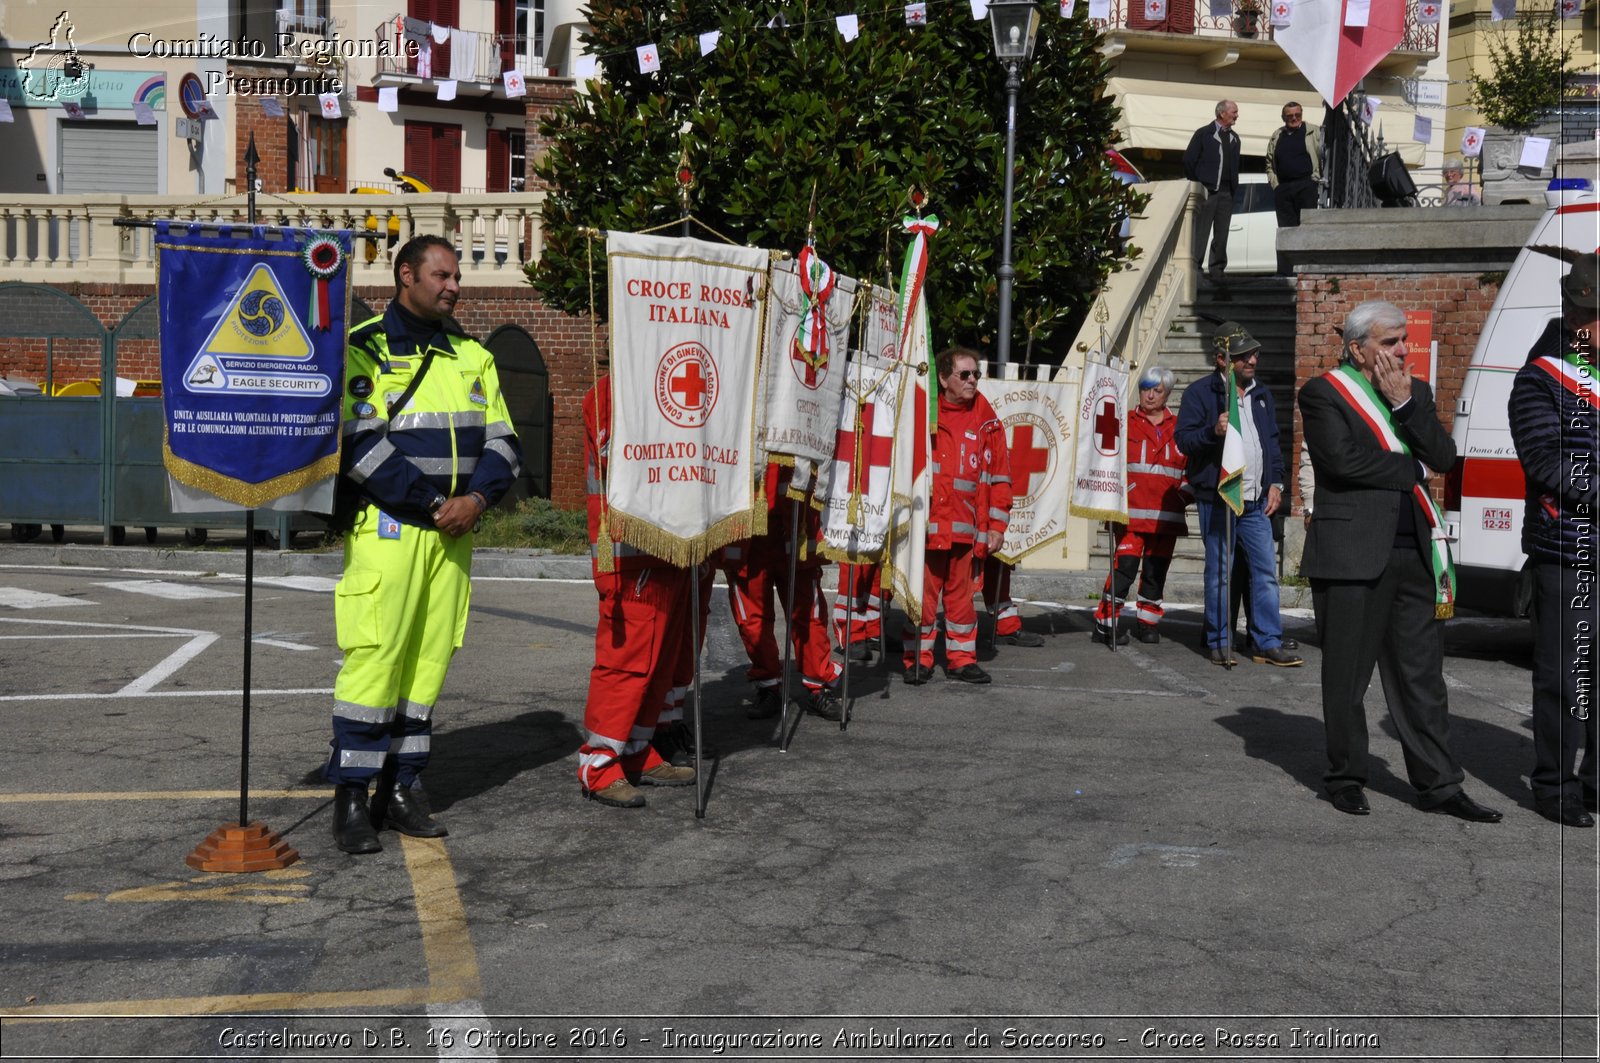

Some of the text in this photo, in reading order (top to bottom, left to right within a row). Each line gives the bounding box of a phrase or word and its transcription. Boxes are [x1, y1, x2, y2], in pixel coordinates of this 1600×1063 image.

[627, 279, 752, 308] CROCE ROSSA
[649, 304, 731, 329] ITALIANA
[231, 320, 291, 345] PROTEZIONE CIVILE
[226, 361, 256, 369] SERVIZIO
[257, 362, 296, 370] EMERGENZA
[666, 354, 677, 366] DI
[233, 378, 320, 389] EAGLE SECURITY
[659, 364, 683, 420] CONVENZIONE
[1082, 387, 1096, 421] CROCE
[174, 410, 335, 424] UNITA' AUSILIARIA VOLONTARIA DI PROTEZIONE CIVILE
[1004, 390, 1040, 405] ROSSA
[1041, 394, 1071, 442] ITALIANA
[173, 423, 186, 433] PER
[188, 424, 196, 433] LE
[197, 424, 247, 435] COMUNICAZIONI
[248, 425, 287, 436] ALTERNATIVE
[289, 426, 293, 436] E
[295, 427, 302, 436] DI
[623, 442, 739, 465] COMITATO LOCALE
[1469, 446, 1492, 454] Dono
[1494, 447, 1503, 455] di
[648, 465, 717, 485] DI CANELLI
[1484, 519, 1511, 529] 12-25
[1485, 510, 1511, 519] AT 14
[1026, 519, 1058, 548] D'ASTI
